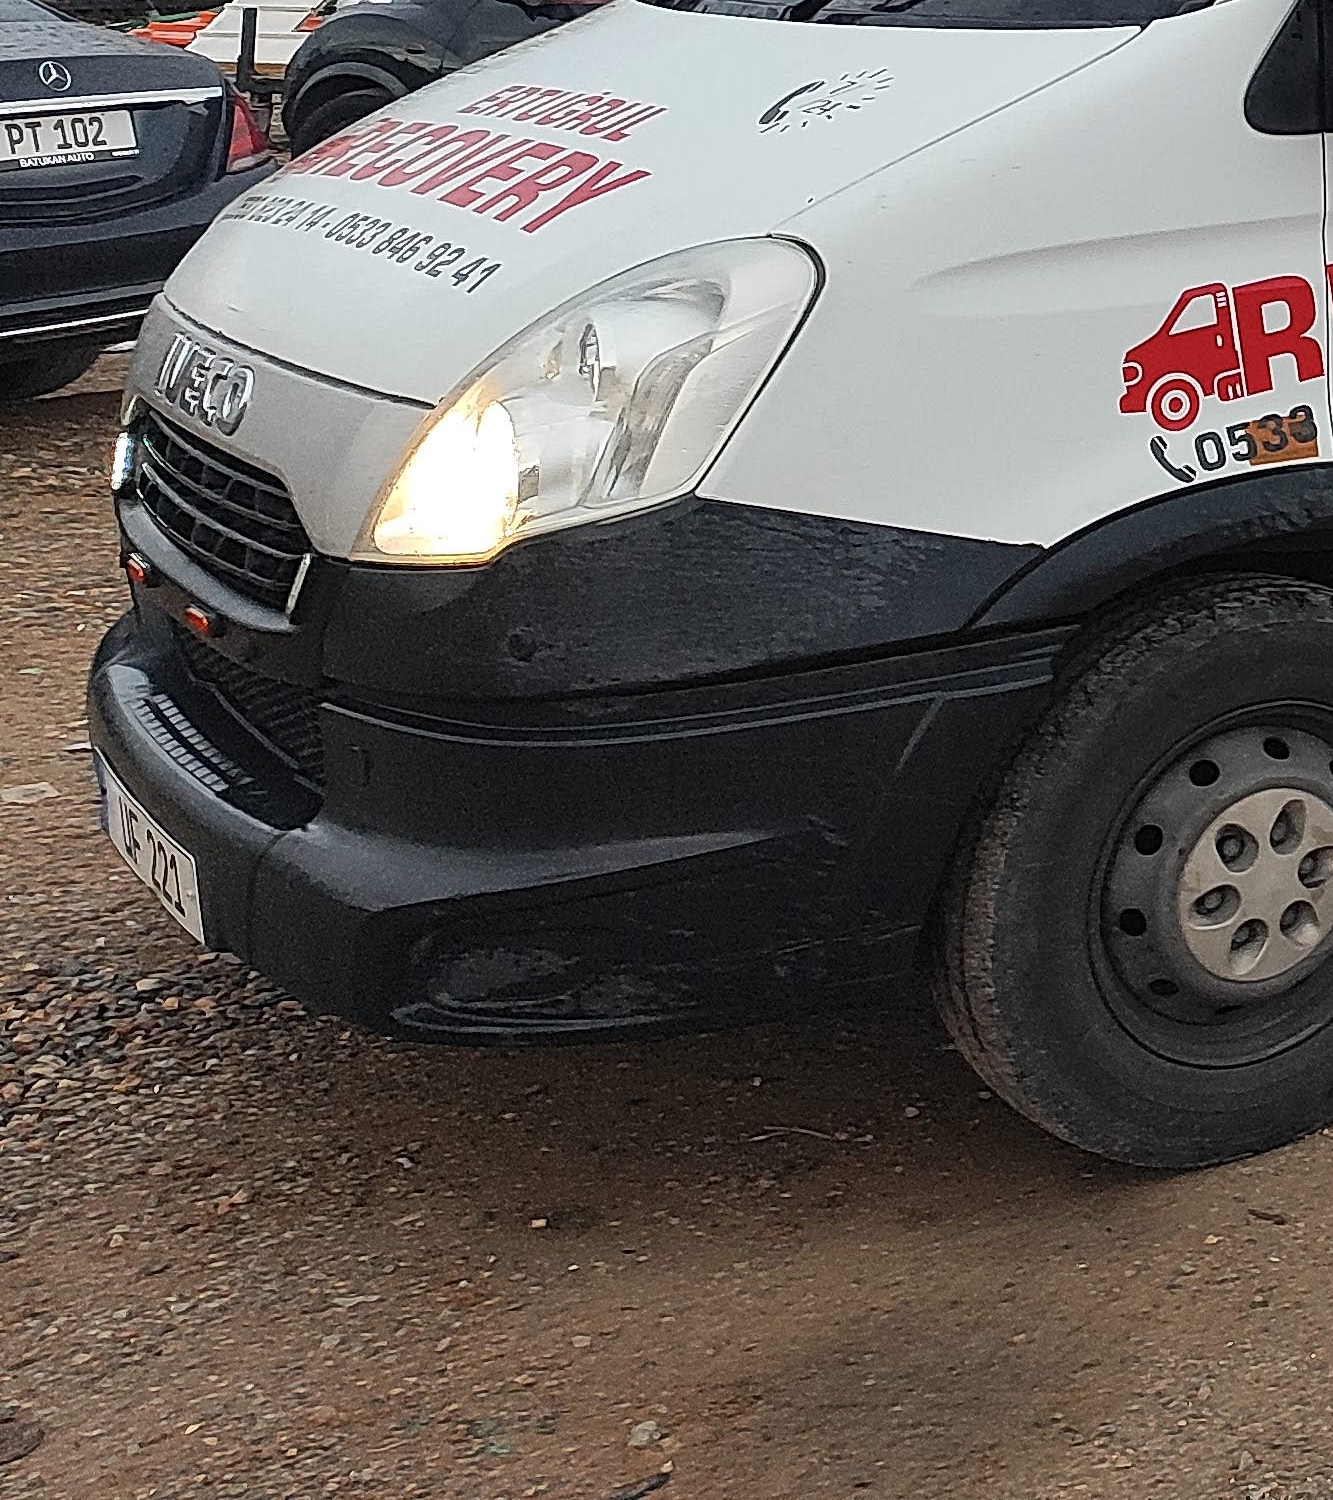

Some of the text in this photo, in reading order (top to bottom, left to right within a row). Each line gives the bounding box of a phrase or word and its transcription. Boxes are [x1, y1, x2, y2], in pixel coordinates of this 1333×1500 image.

[5, 116, 107, 154] PT 102
[67, 152, 95, 163] AUTO
[287, 117, 652, 233] RECOVERY
[324, 212, 392, 248] 0533
[371, 227, 434, 263] 846
[413, 242, 466, 277] 92
[451, 257, 502, 293] 41
[154, 332, 255, 434] IVECO
[1194, 404, 1319, 472] 0533
[146, 828, 187, 918] 221
